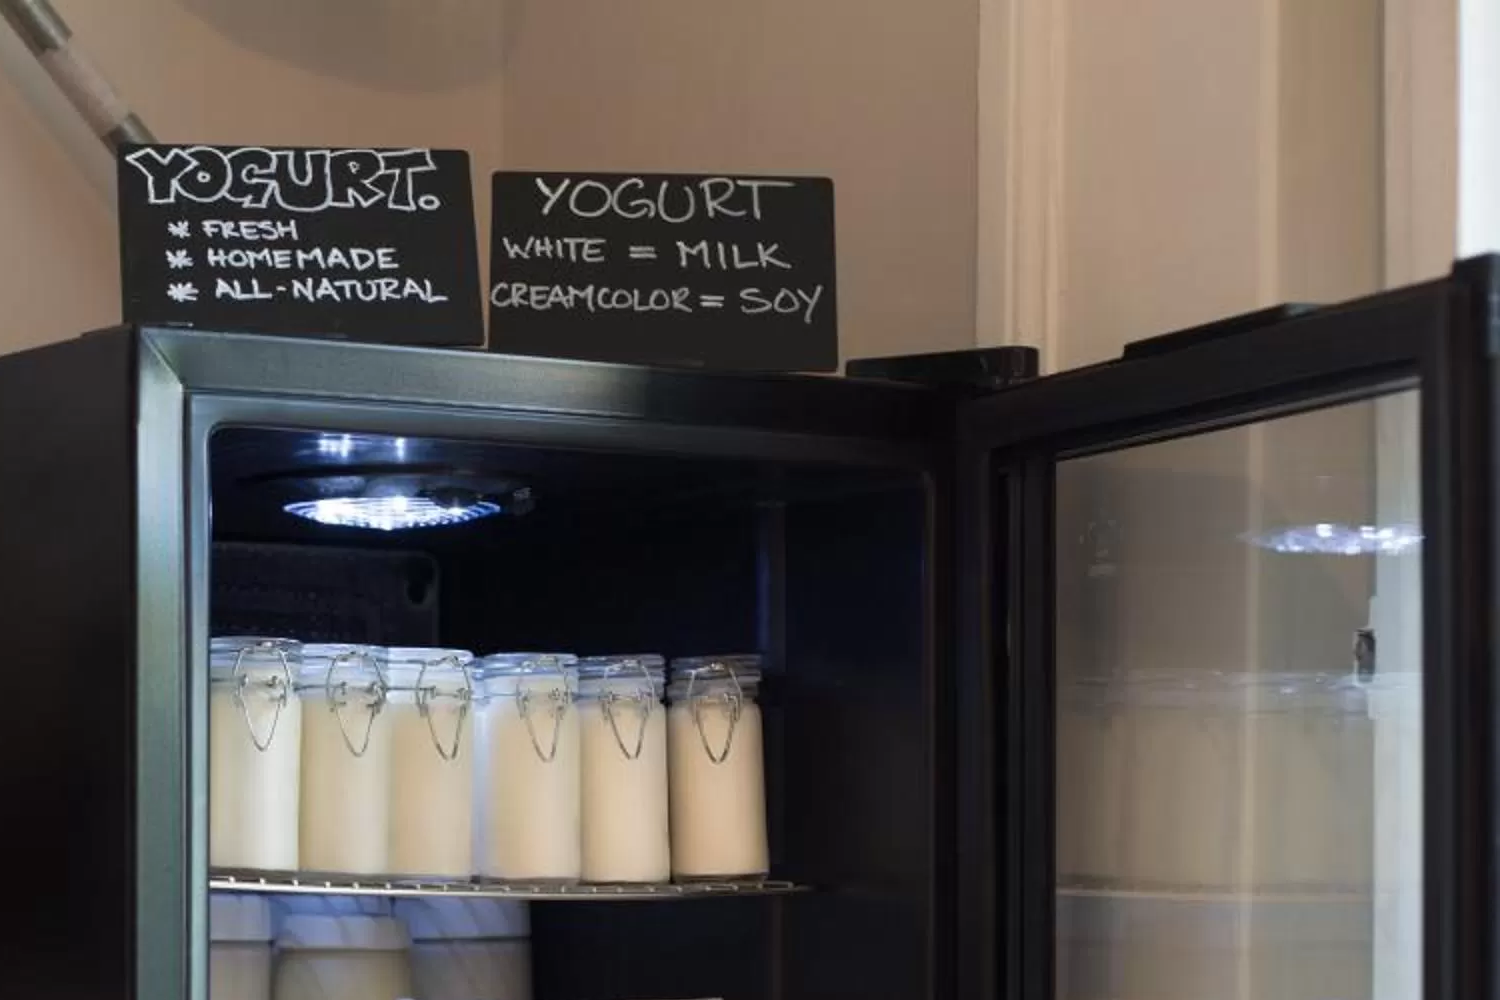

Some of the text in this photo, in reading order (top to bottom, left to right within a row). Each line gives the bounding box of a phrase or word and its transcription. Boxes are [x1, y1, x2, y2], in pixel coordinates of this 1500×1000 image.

[125, 147, 441, 212] YOGURT.
[535, 177, 797, 223] YOGURT
[202, 219, 299, 241] FRESH
[206, 248, 400, 270] HOMEMADE
[502, 236, 607, 263] WHITE
[676, 240, 793, 270] MILK
[214, 278, 449, 303] ALL-NATURAL
[739, 284, 824, 324] SOY
